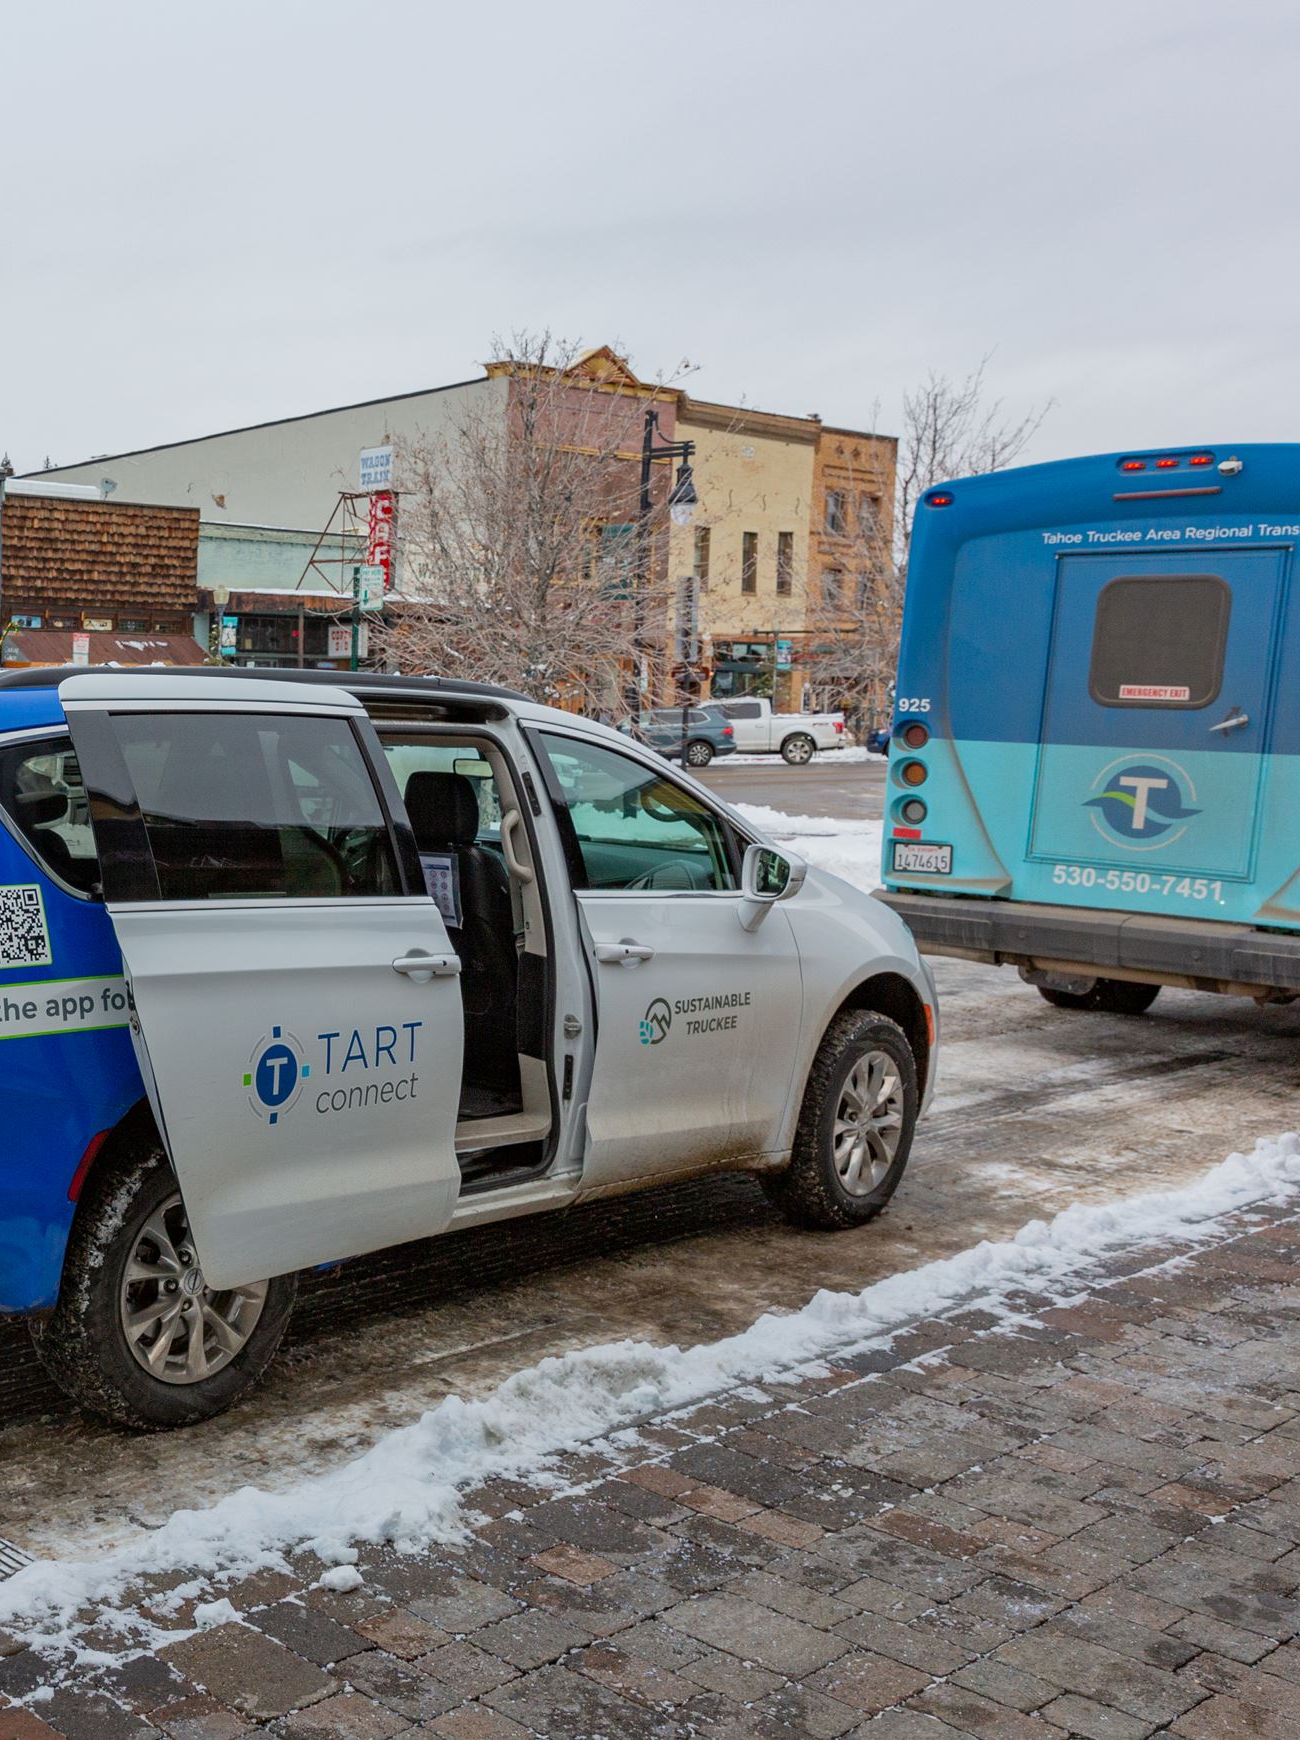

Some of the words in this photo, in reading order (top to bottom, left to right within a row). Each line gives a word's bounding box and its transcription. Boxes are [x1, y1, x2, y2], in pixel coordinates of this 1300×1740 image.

[361, 453, 391, 470] WAGON
[361, 470, 390, 486] TRAIN
[1042, 532, 1083, 544] Tahoe
[1087, 530, 1142, 543] Truckee
[1145, 528, 1181, 540] Area
[1185, 524, 1253, 541] Regional
[1122, 687, 1167, 697] EMERGENCY
[1170, 689, 1187, 698] EXIT
[898, 698, 931, 713] 925
[897, 853, 948, 870] 1474615
[1052, 864, 1222, 901] 530-550-7451
[46, 995, 94, 1021] app
[674, 991, 751, 1015] SUSTAINABLE
[686, 1015, 738, 1035] TRUCKEE
[317, 1021, 422, 1074] TART
[316, 1072, 419, 1114] connect
